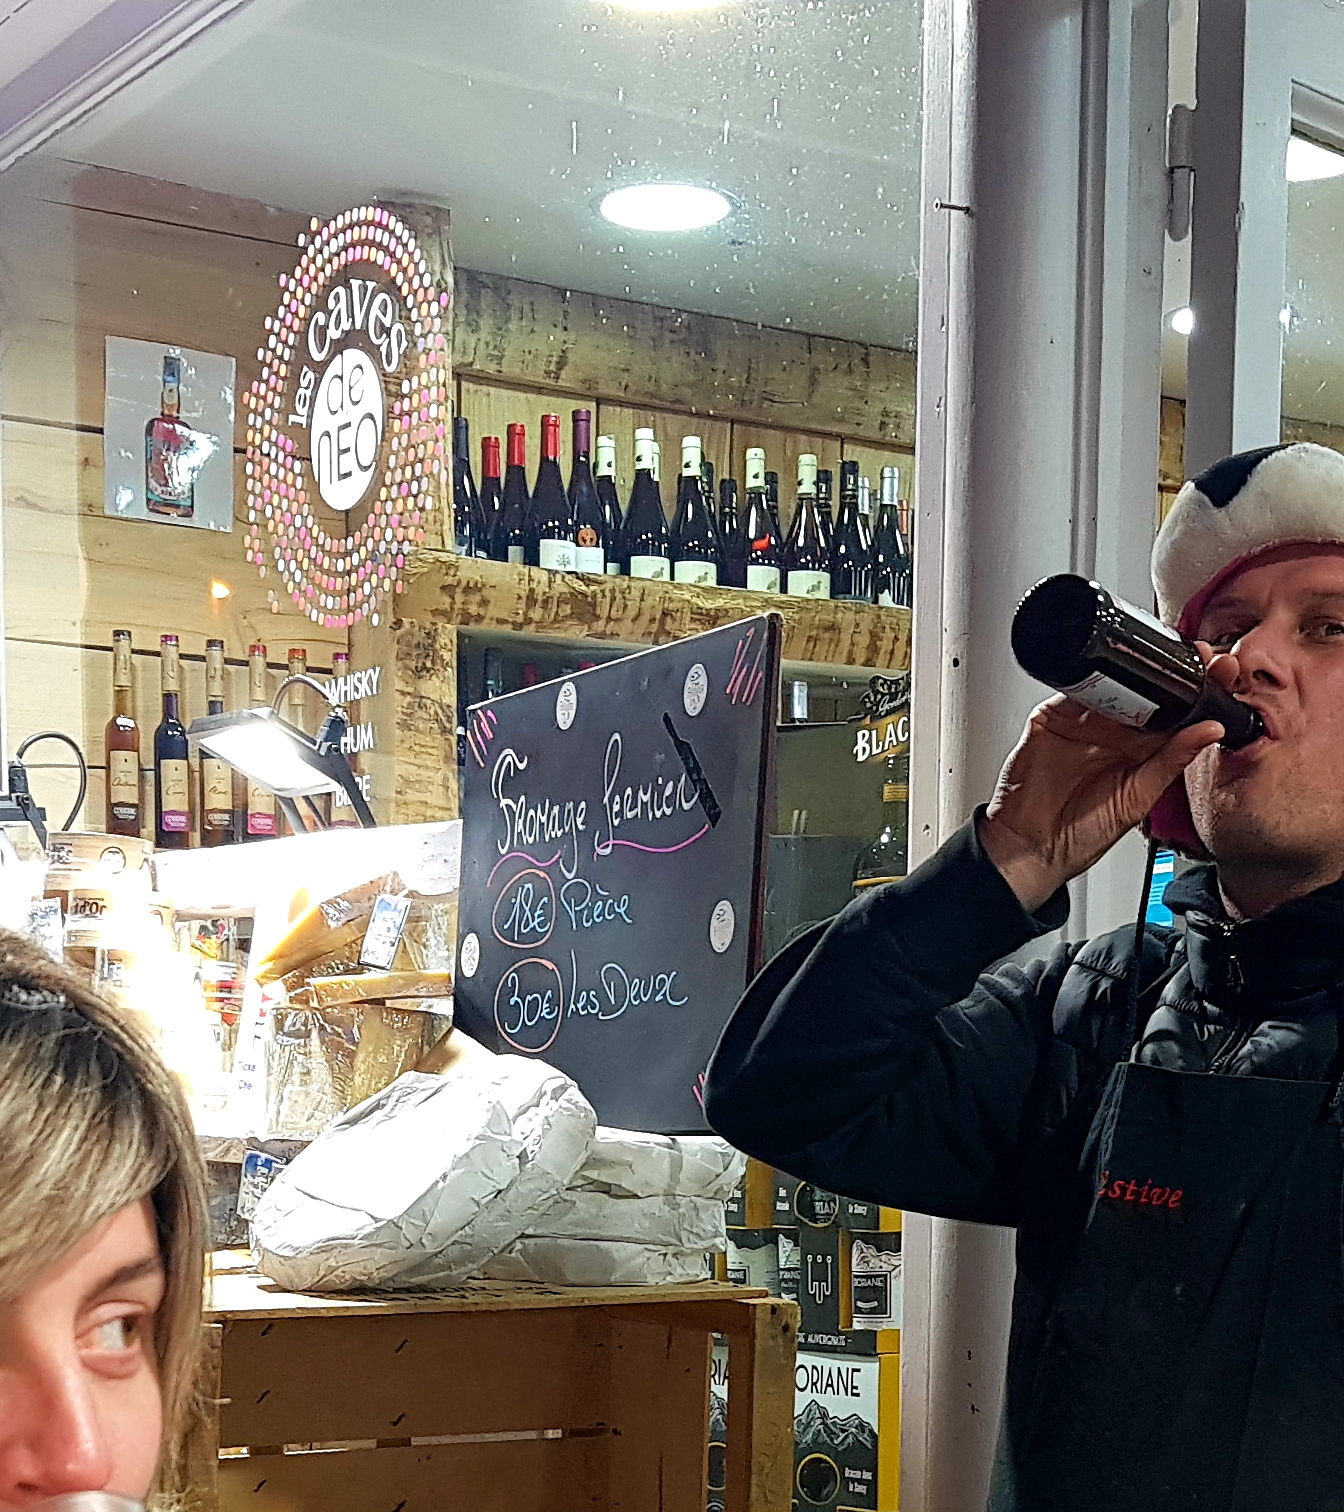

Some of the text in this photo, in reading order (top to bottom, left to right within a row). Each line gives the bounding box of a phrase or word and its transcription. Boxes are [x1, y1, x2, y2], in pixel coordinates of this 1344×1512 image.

[308, 278, 408, 373] caves
[288, 365, 315, 428] les
[326, 352, 365, 415] de
[325, 666, 380, 705] WHISKY
[503, 883, 551, 941] 18€
[505, 972, 559, 1033] 30€
[598, 962, 688, 1020] Deux
[795, 1364, 862, 1398] ORIANE
